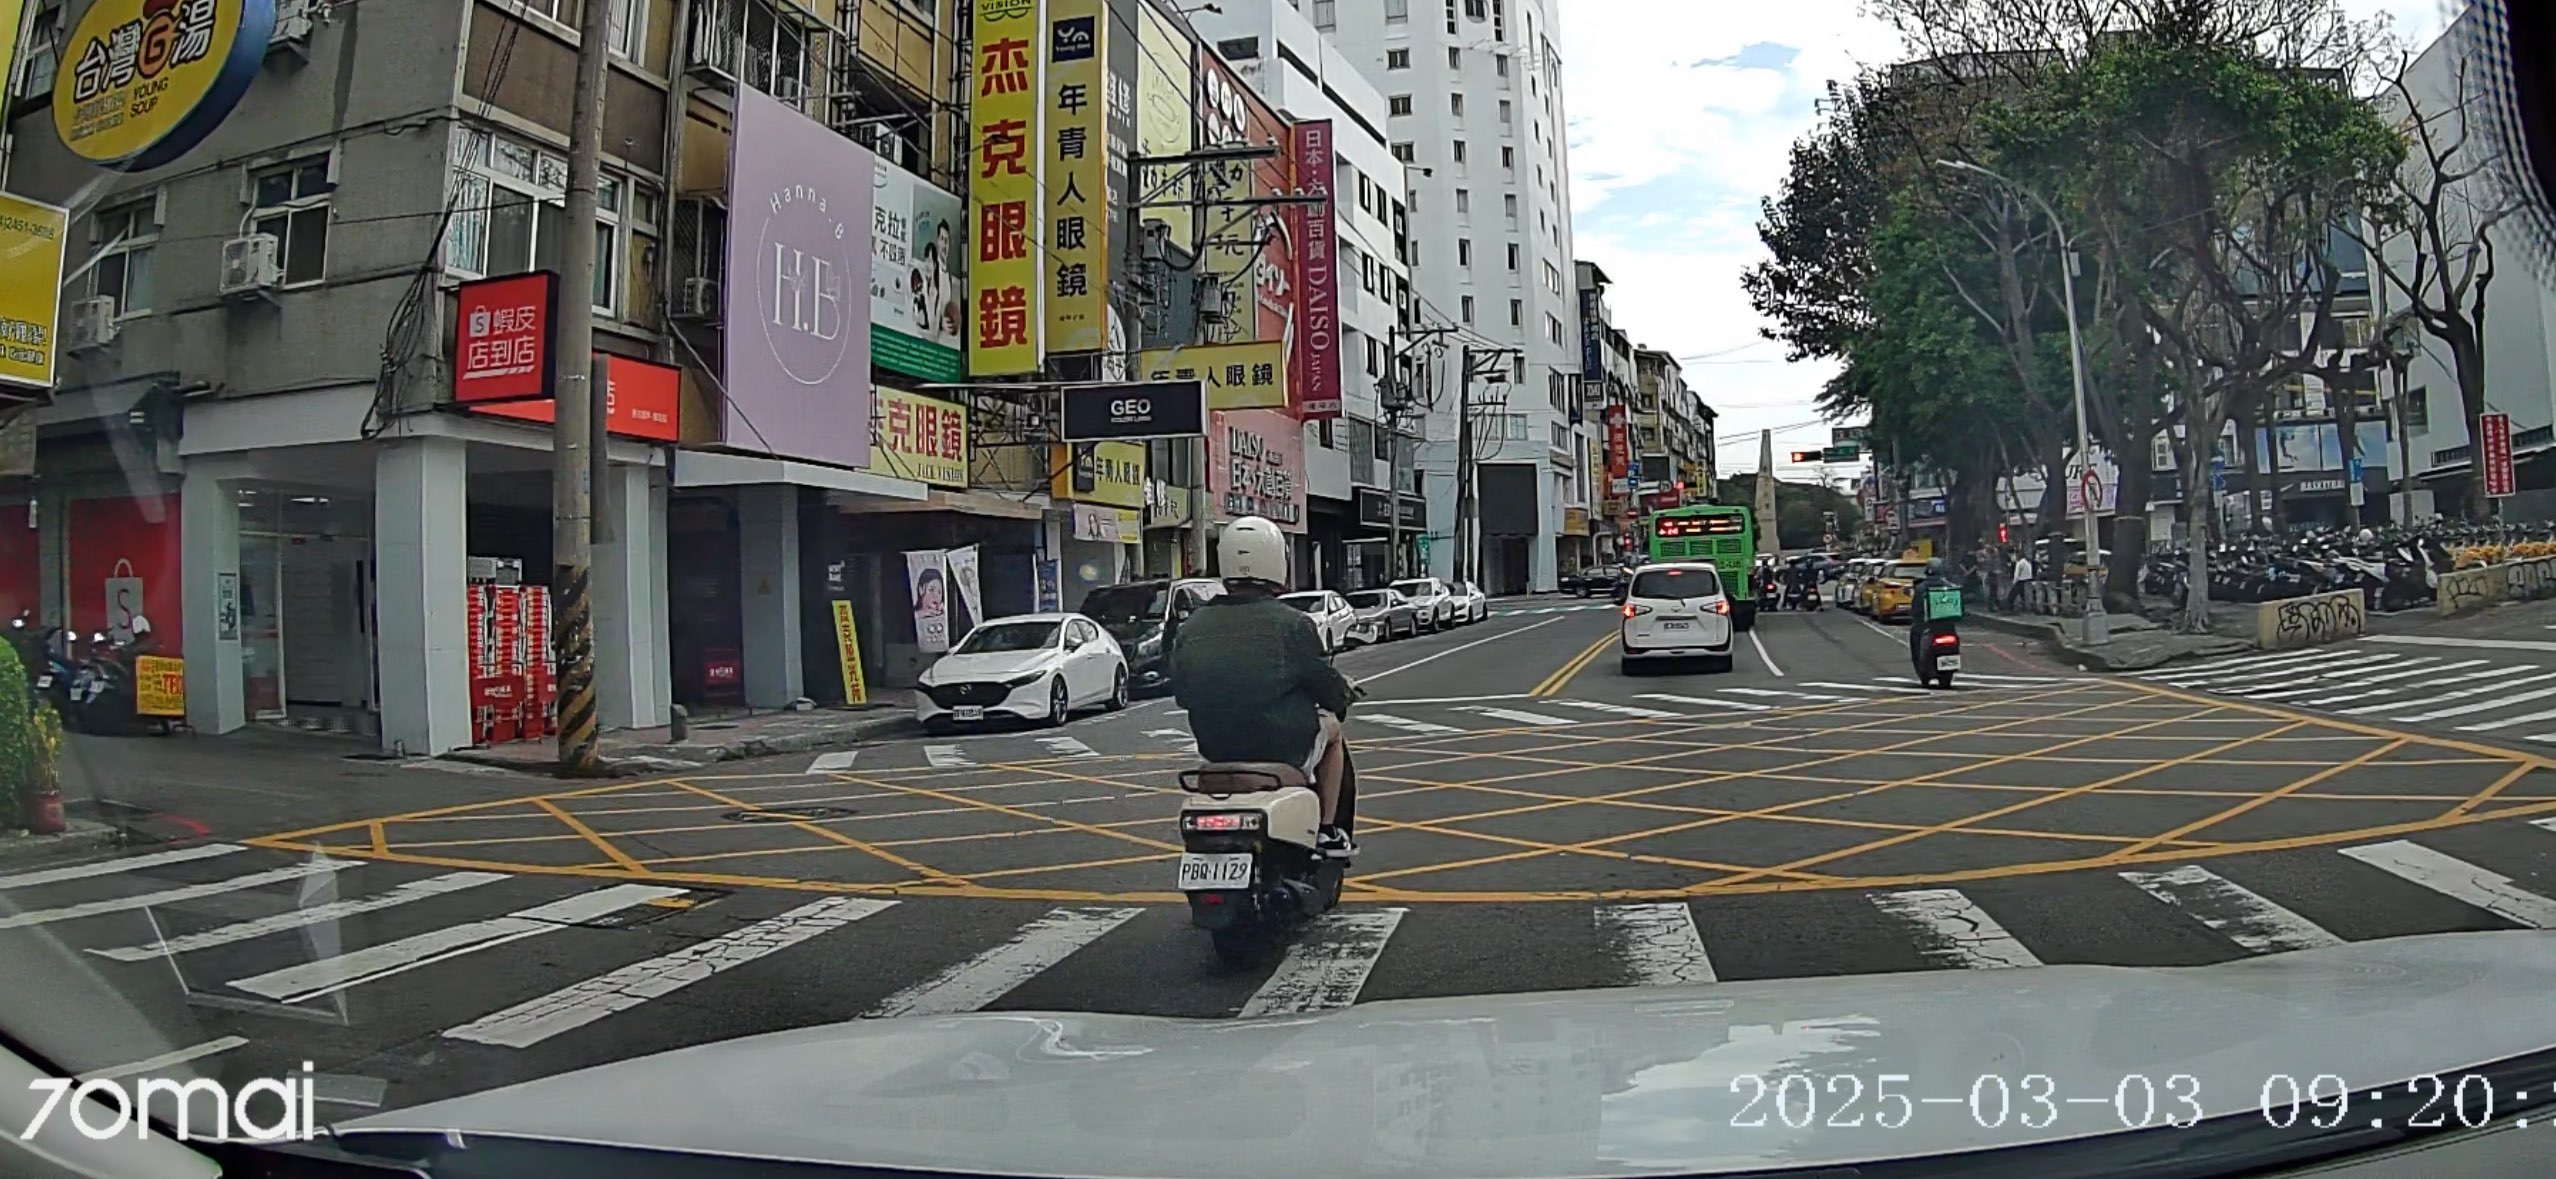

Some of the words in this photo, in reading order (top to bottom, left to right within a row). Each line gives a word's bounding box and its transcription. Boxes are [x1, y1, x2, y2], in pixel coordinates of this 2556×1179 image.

[133, 77, 170, 101] YOUNG
[130, 98, 158, 118] SOUP
[980, 37, 1029, 349] 杰克眼鏡
[1056, 84, 1088, 298] 年青人眼鏡
[492, 304, 536, 334] 蝦皮
[1308, 264, 1331, 351] DAISO
[467, 335, 536, 370] 店到店
[1110, 399, 1151, 416] GEO
[1181, 862, 1249, 881] PBQ-1129
